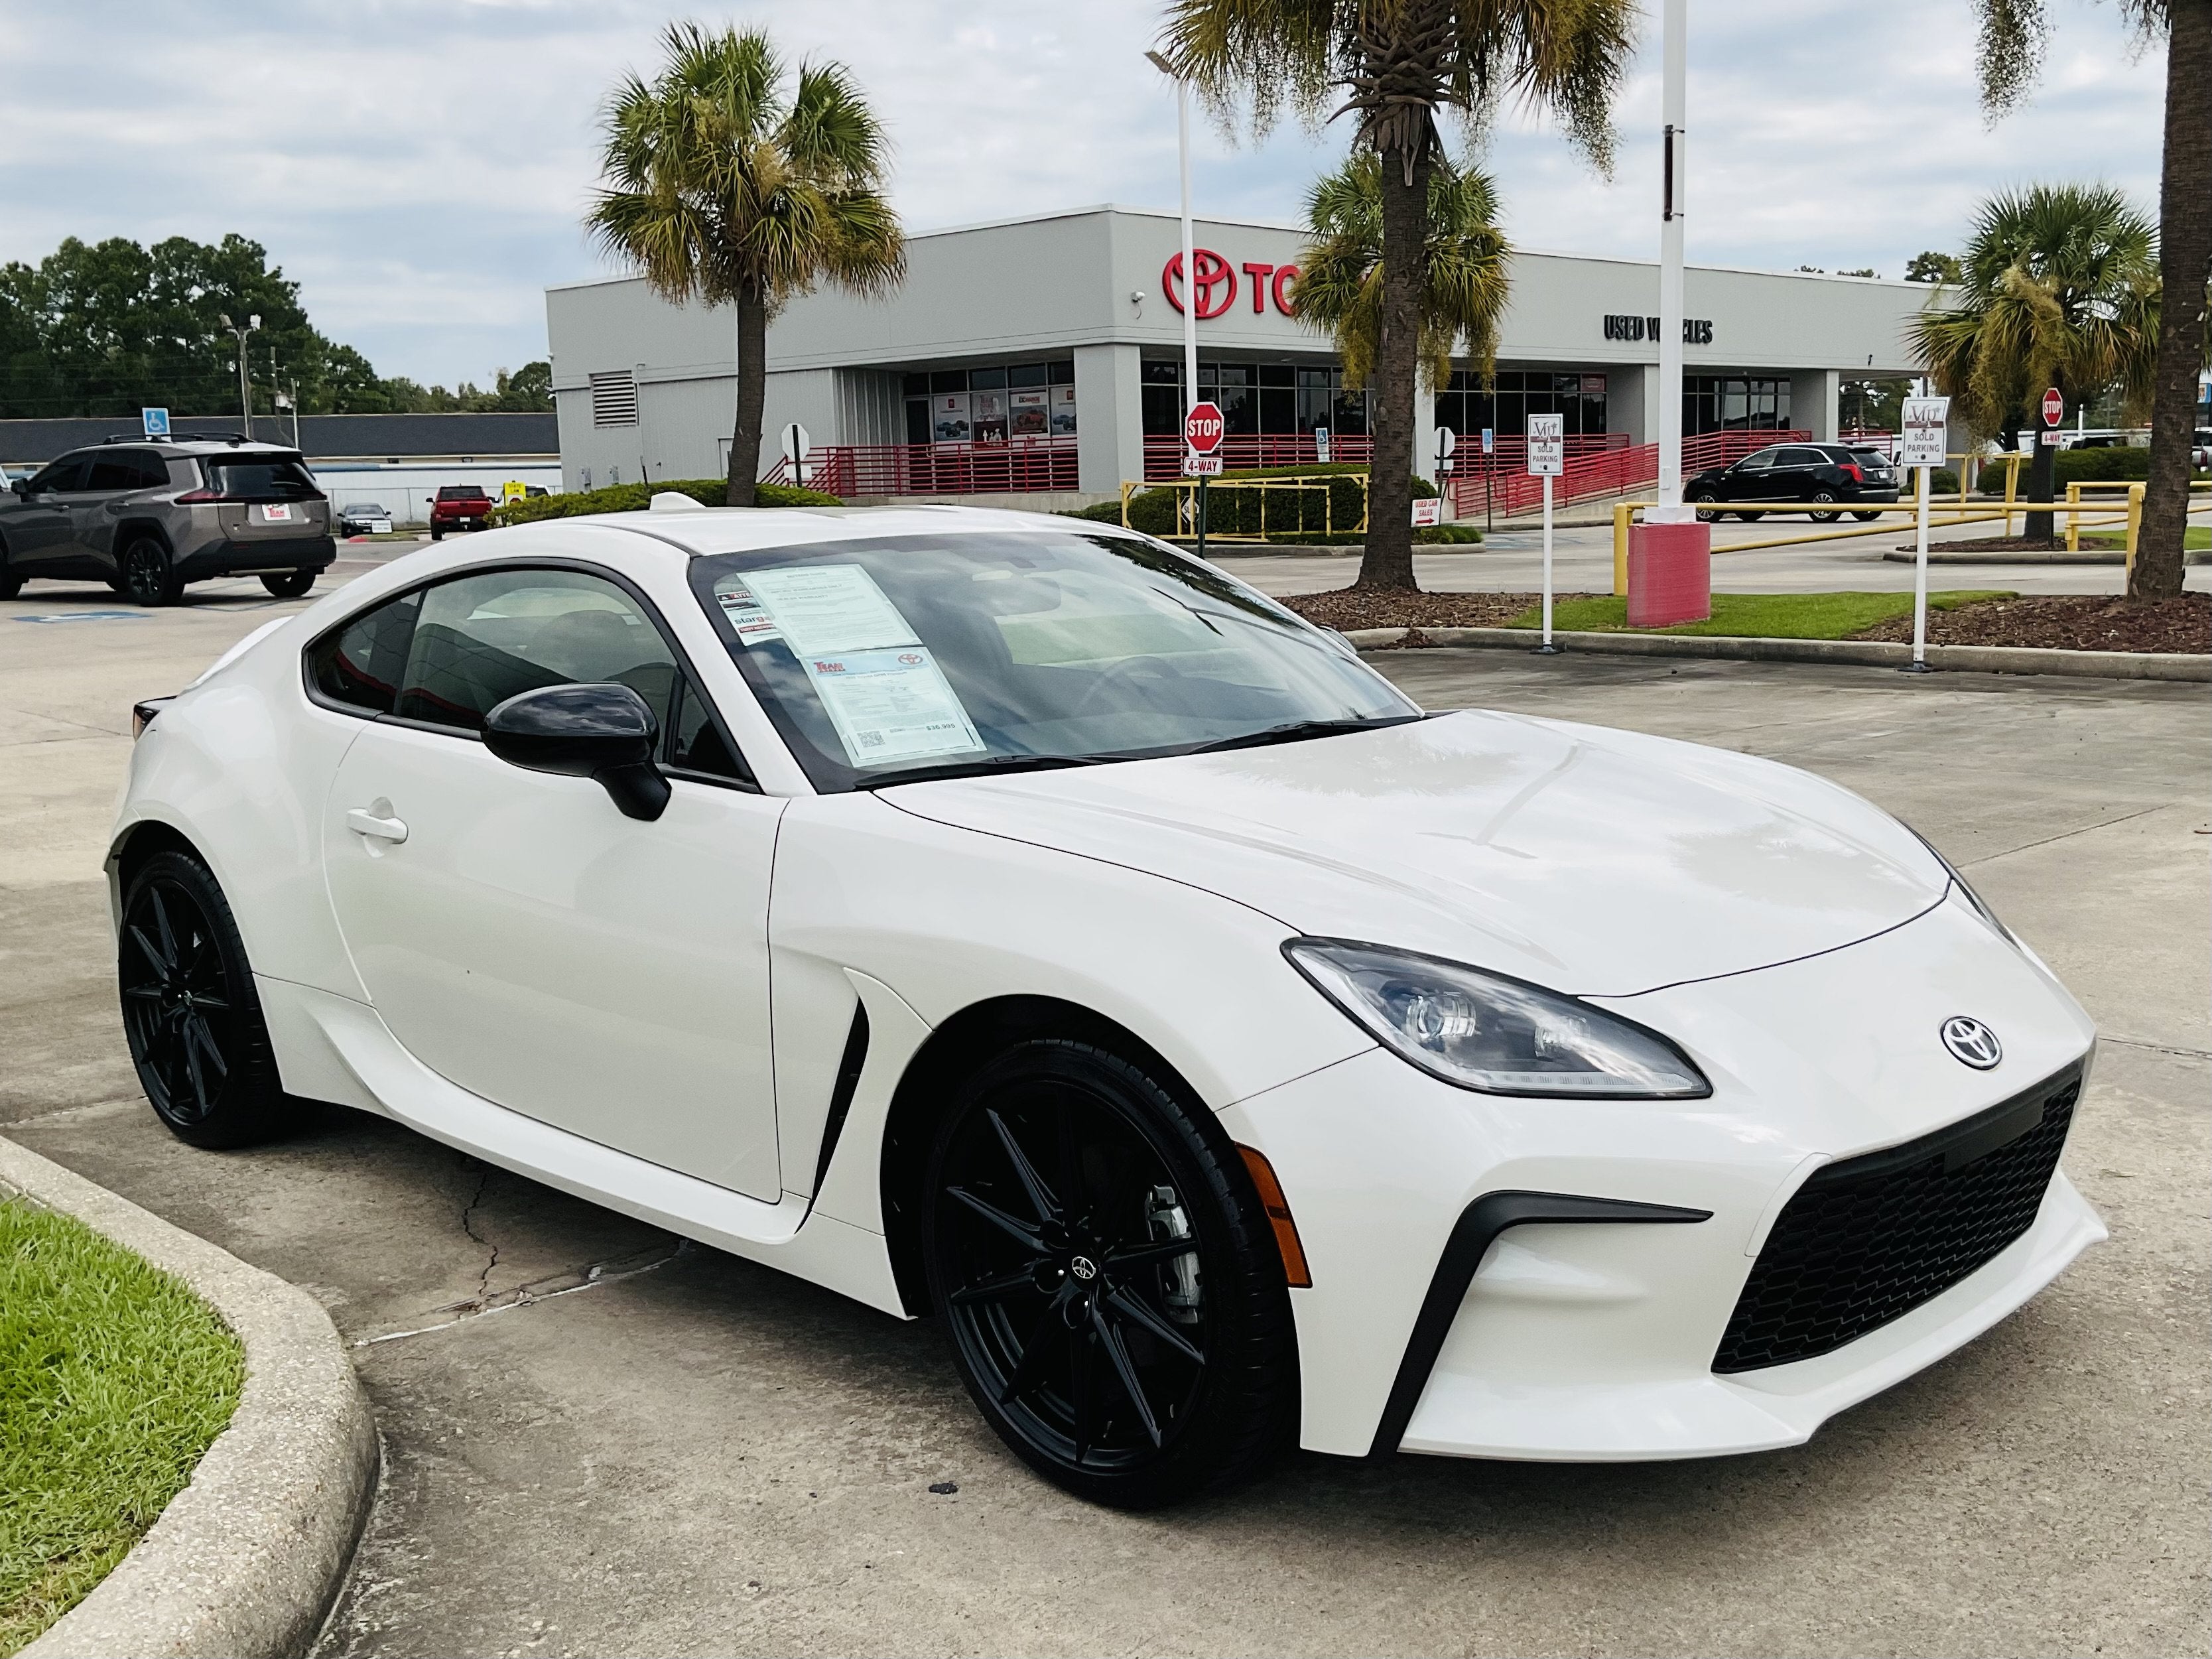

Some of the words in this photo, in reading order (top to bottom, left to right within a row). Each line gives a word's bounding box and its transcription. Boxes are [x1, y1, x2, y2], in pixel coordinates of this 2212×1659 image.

[1604, 314, 1645, 341] USED
[1646, 316, 1713, 344] VCLES
[2044, 401, 2061, 414] STOP
[1188, 419, 1221, 437] STOP
[2044, 434, 2061, 442] 4-WAY
[1188, 460, 1218, 472] 4-WAY
